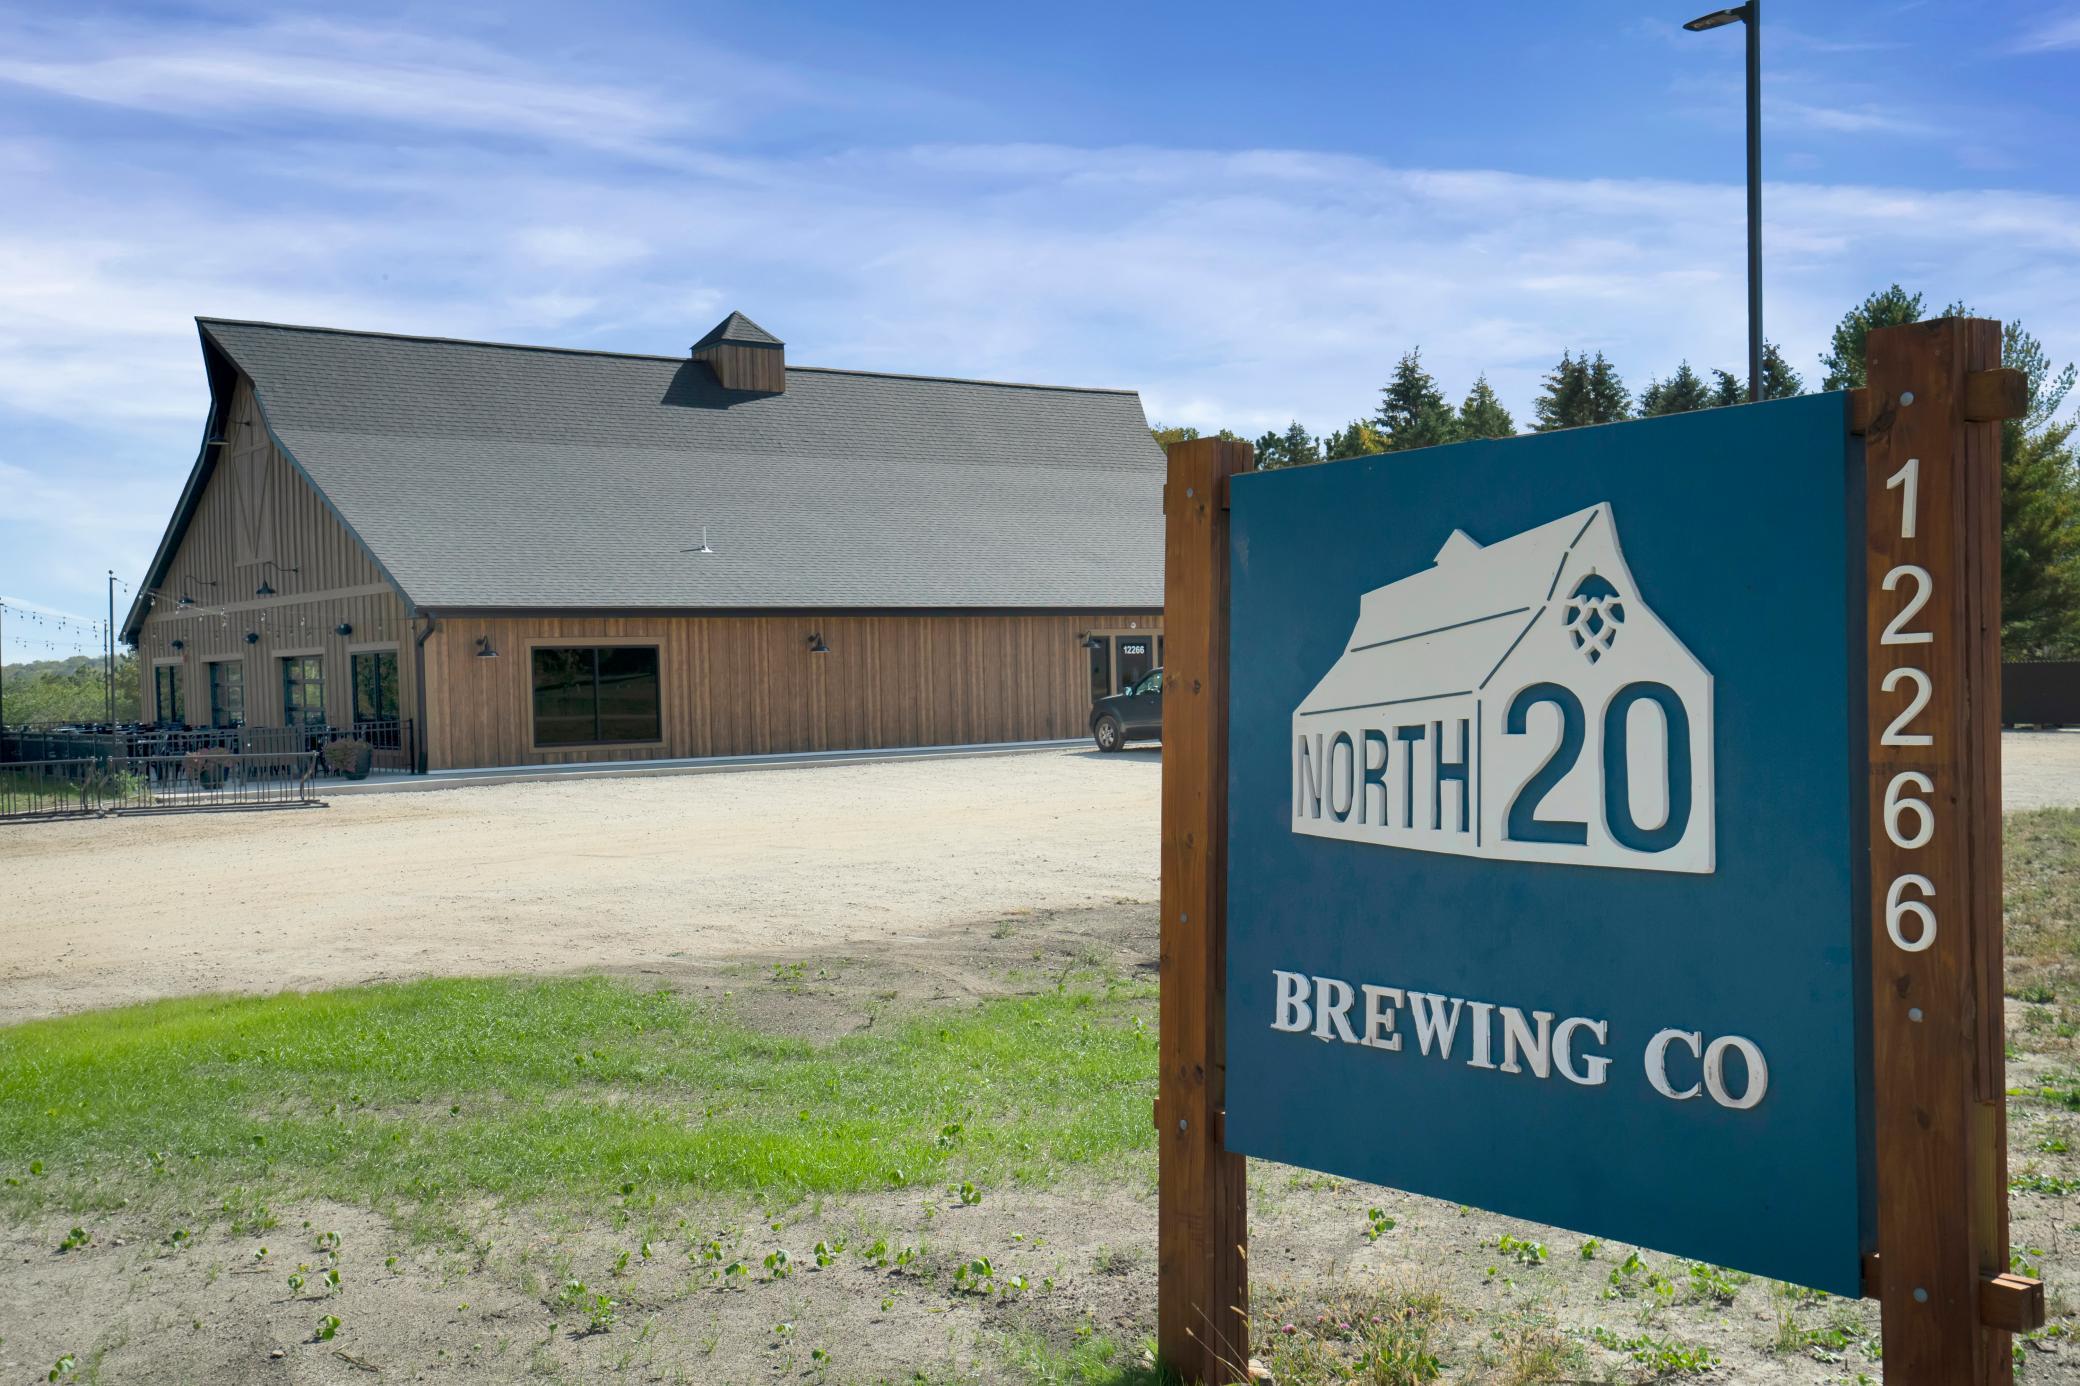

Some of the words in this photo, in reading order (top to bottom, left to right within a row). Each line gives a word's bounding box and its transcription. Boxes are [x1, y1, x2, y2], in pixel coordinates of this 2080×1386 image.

[1123, 645, 1145, 655] 12266
[1880, 458, 1937, 953] 12266
[1296, 718, 1471, 834] NORTH
[1501, 681, 1692, 853] 20
[1270, 969, 1613, 1086] BREWING
[1644, 1028, 1768, 1110] CO
